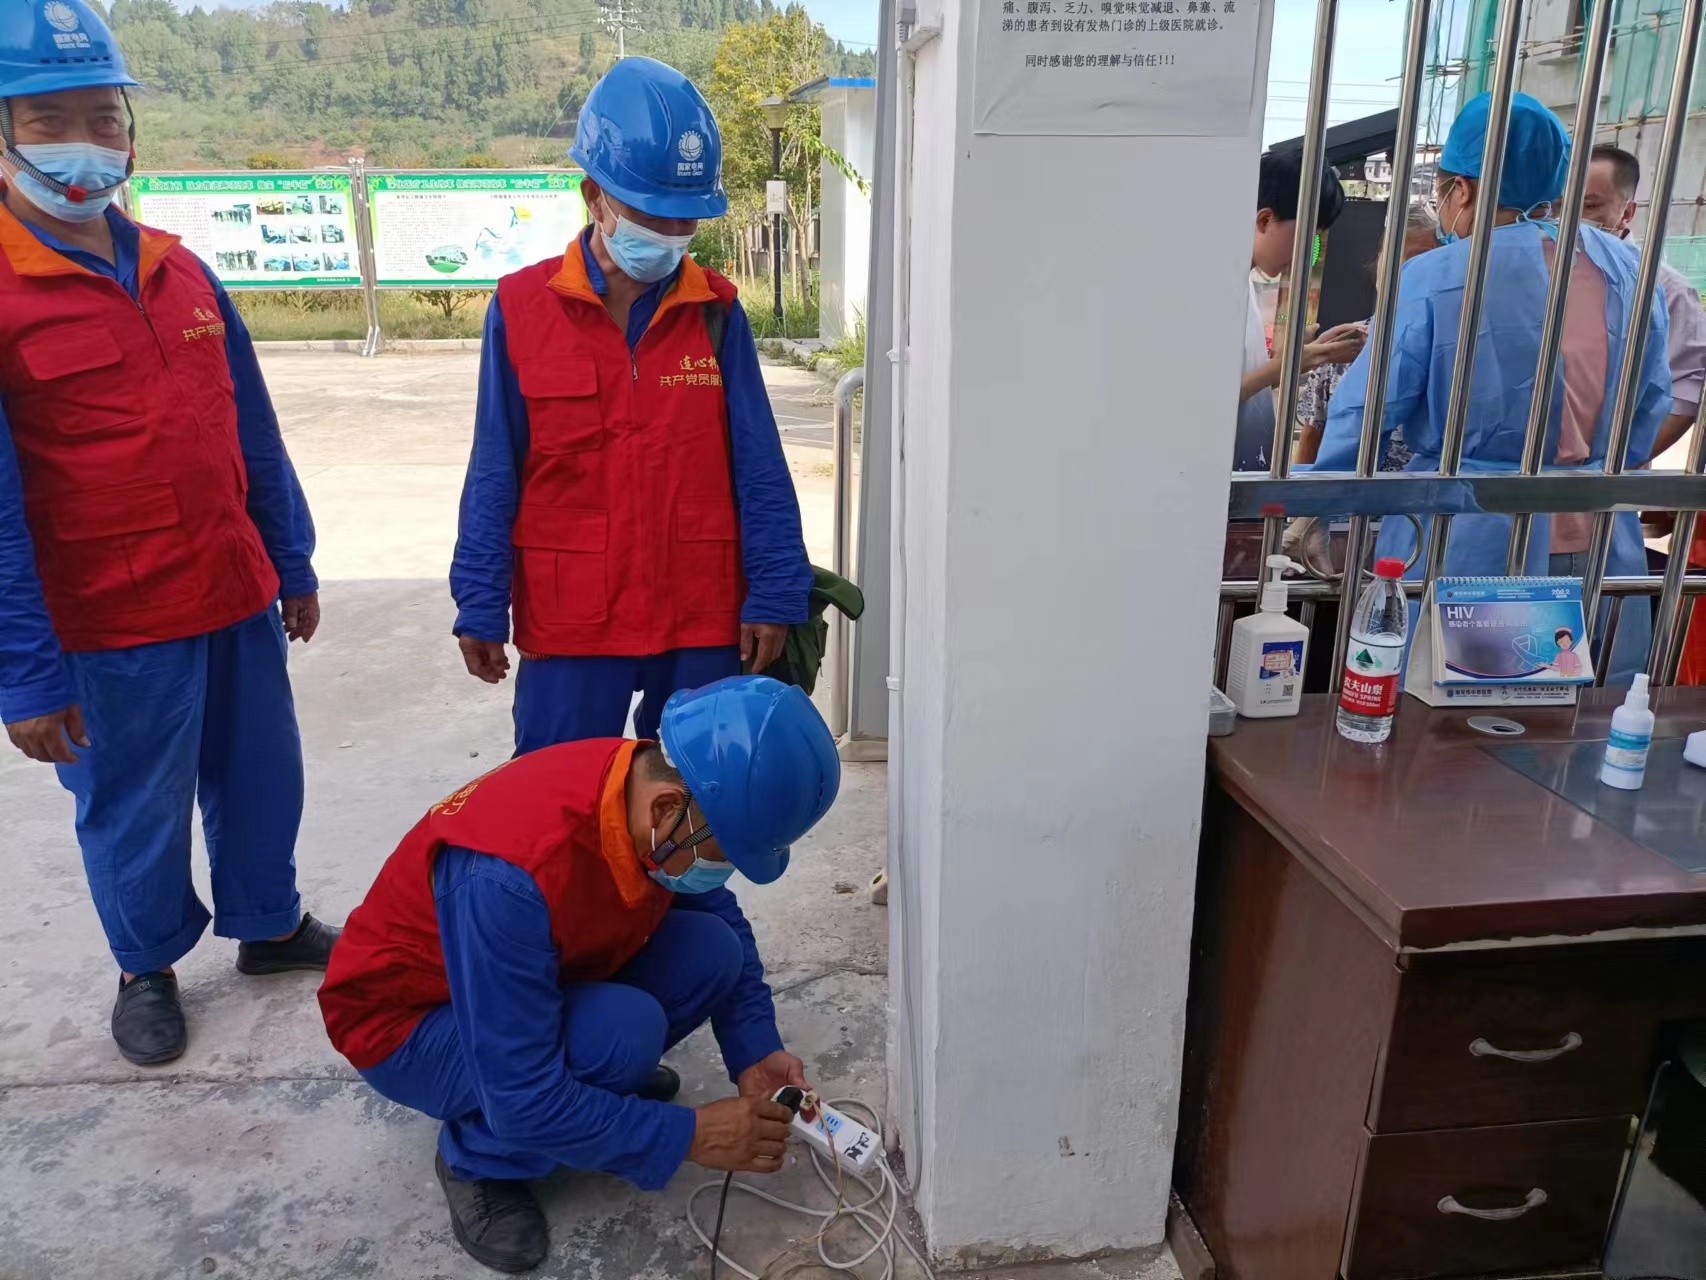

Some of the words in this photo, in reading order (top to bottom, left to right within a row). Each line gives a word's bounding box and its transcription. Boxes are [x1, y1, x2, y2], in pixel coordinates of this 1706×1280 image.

[1002, 1, 1235, 15] 痛、腹泻、乏力、嗅觉味觉减退、鼻塞、流
[1001, 18, 1224, 32] 涕的患者到设有发热门诊的上级医院就诊。
[677, 162, 703, 171] 国家电网
[1447, 606, 1474, 619] HIV
[1343, 676, 1383, 695] 农夫山泉
[1359, 693, 1381, 702] SPRING
